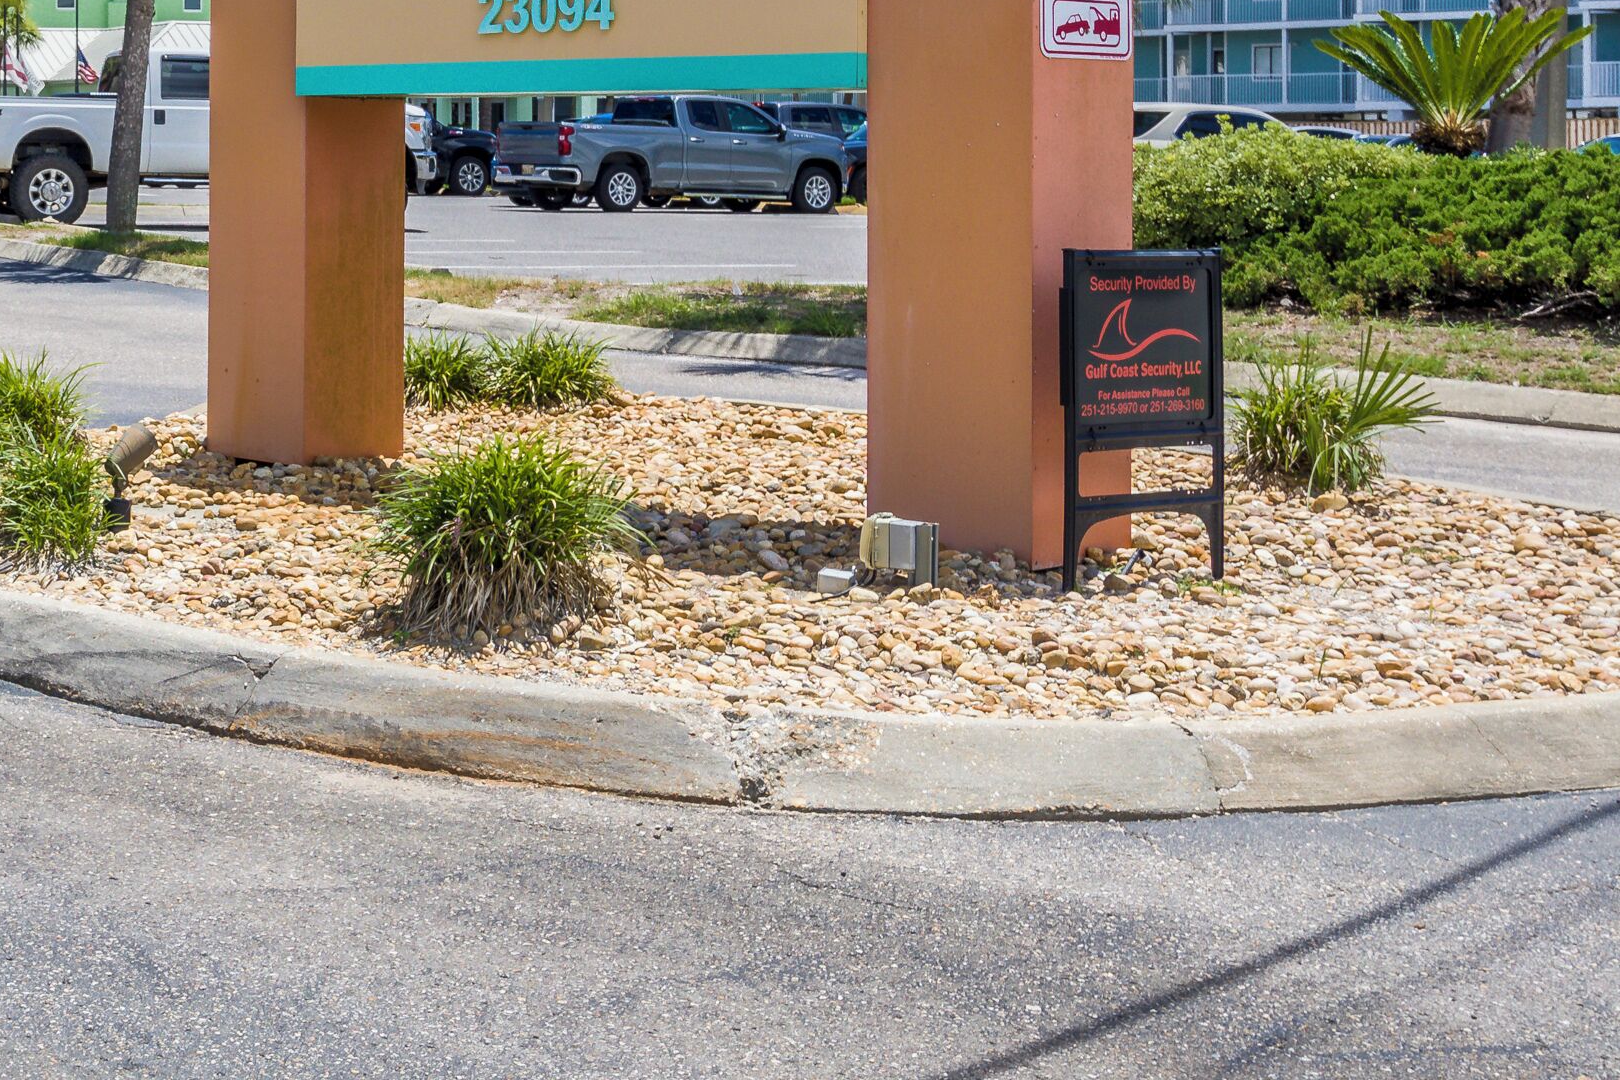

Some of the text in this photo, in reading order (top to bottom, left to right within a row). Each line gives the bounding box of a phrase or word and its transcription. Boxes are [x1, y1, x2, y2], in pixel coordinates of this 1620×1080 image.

[1090, 275, 1196, 294] Security Provided By
[1085, 359, 1202, 379] Gulf Coast Security, LLC
[1098, 386, 1190, 400] For Assistance Please Call
[1139, 403, 1148, 413] or
